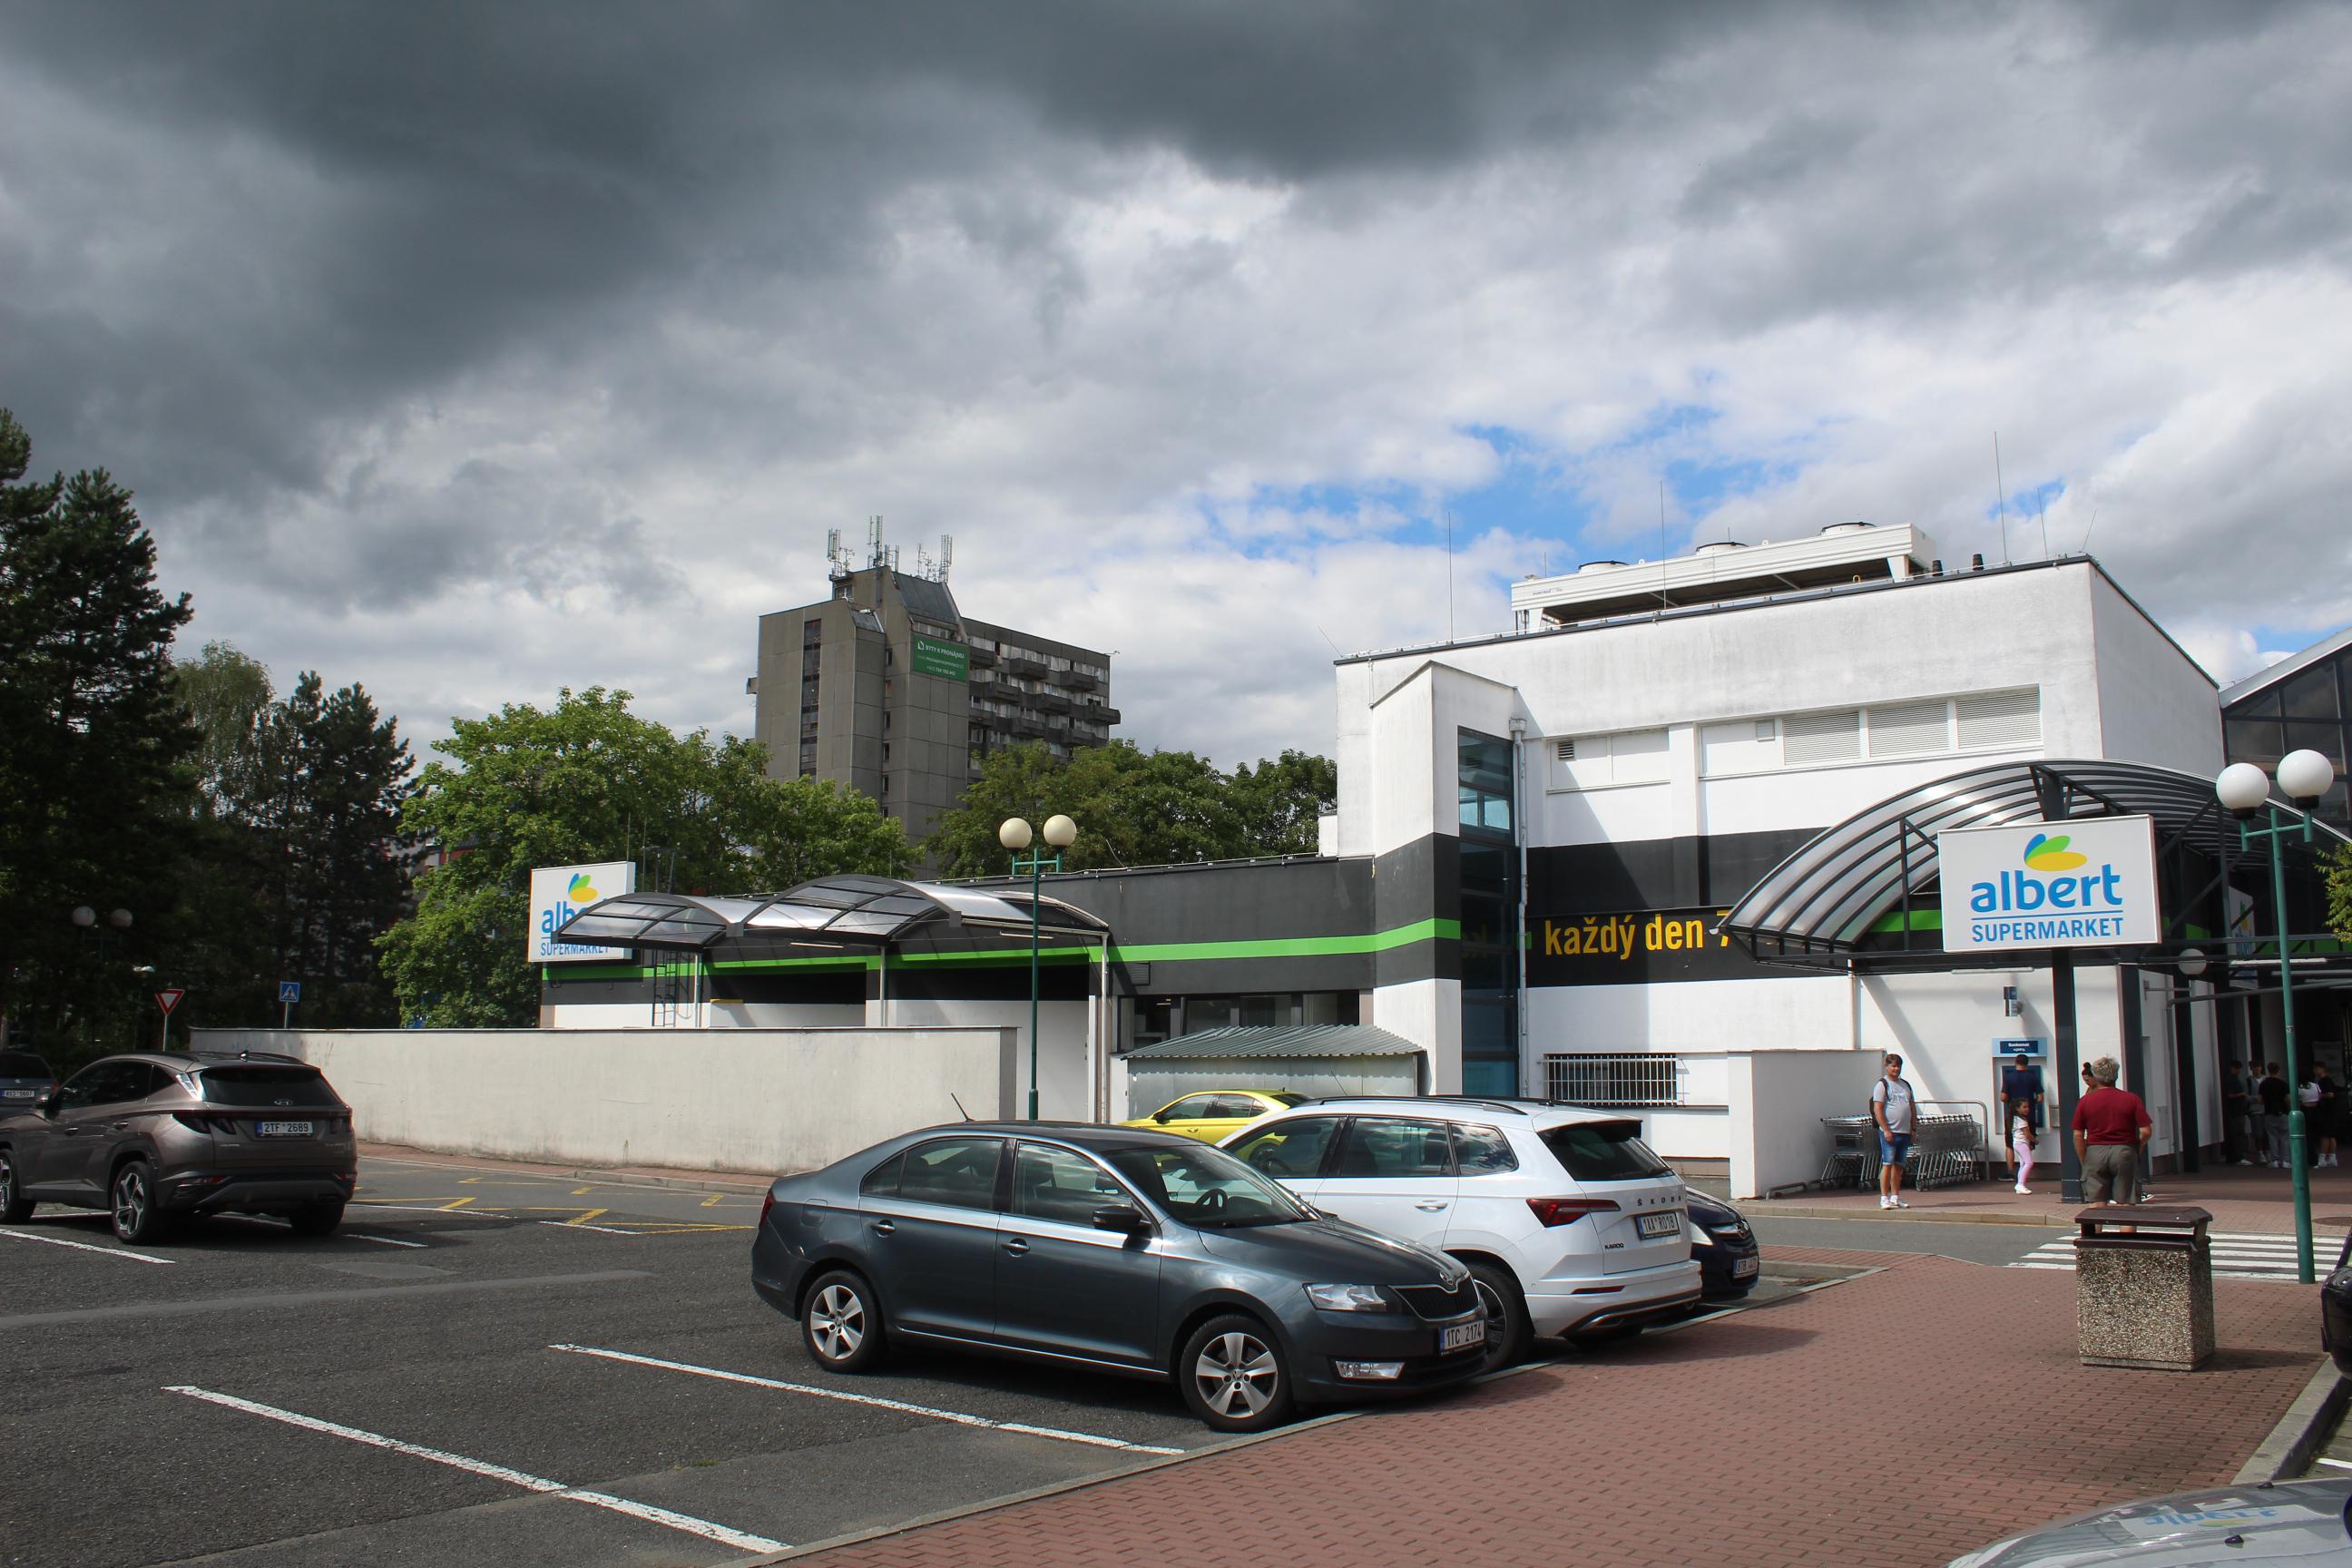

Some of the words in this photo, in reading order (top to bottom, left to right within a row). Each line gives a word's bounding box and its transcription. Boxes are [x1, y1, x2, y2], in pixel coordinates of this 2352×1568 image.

[1970, 864, 2123, 913] albert
[1544, 915, 1636, 960] každý
[1645, 913, 1703, 951] den
[1972, 917, 2123, 943] SUPERMARKET
[264, 1122, 280, 1133] 2TF
[287, 1122, 309, 1132] 2689
[1446, 1328, 1460, 1347] 1TC
[1465, 1322, 1482, 1342] 2174
